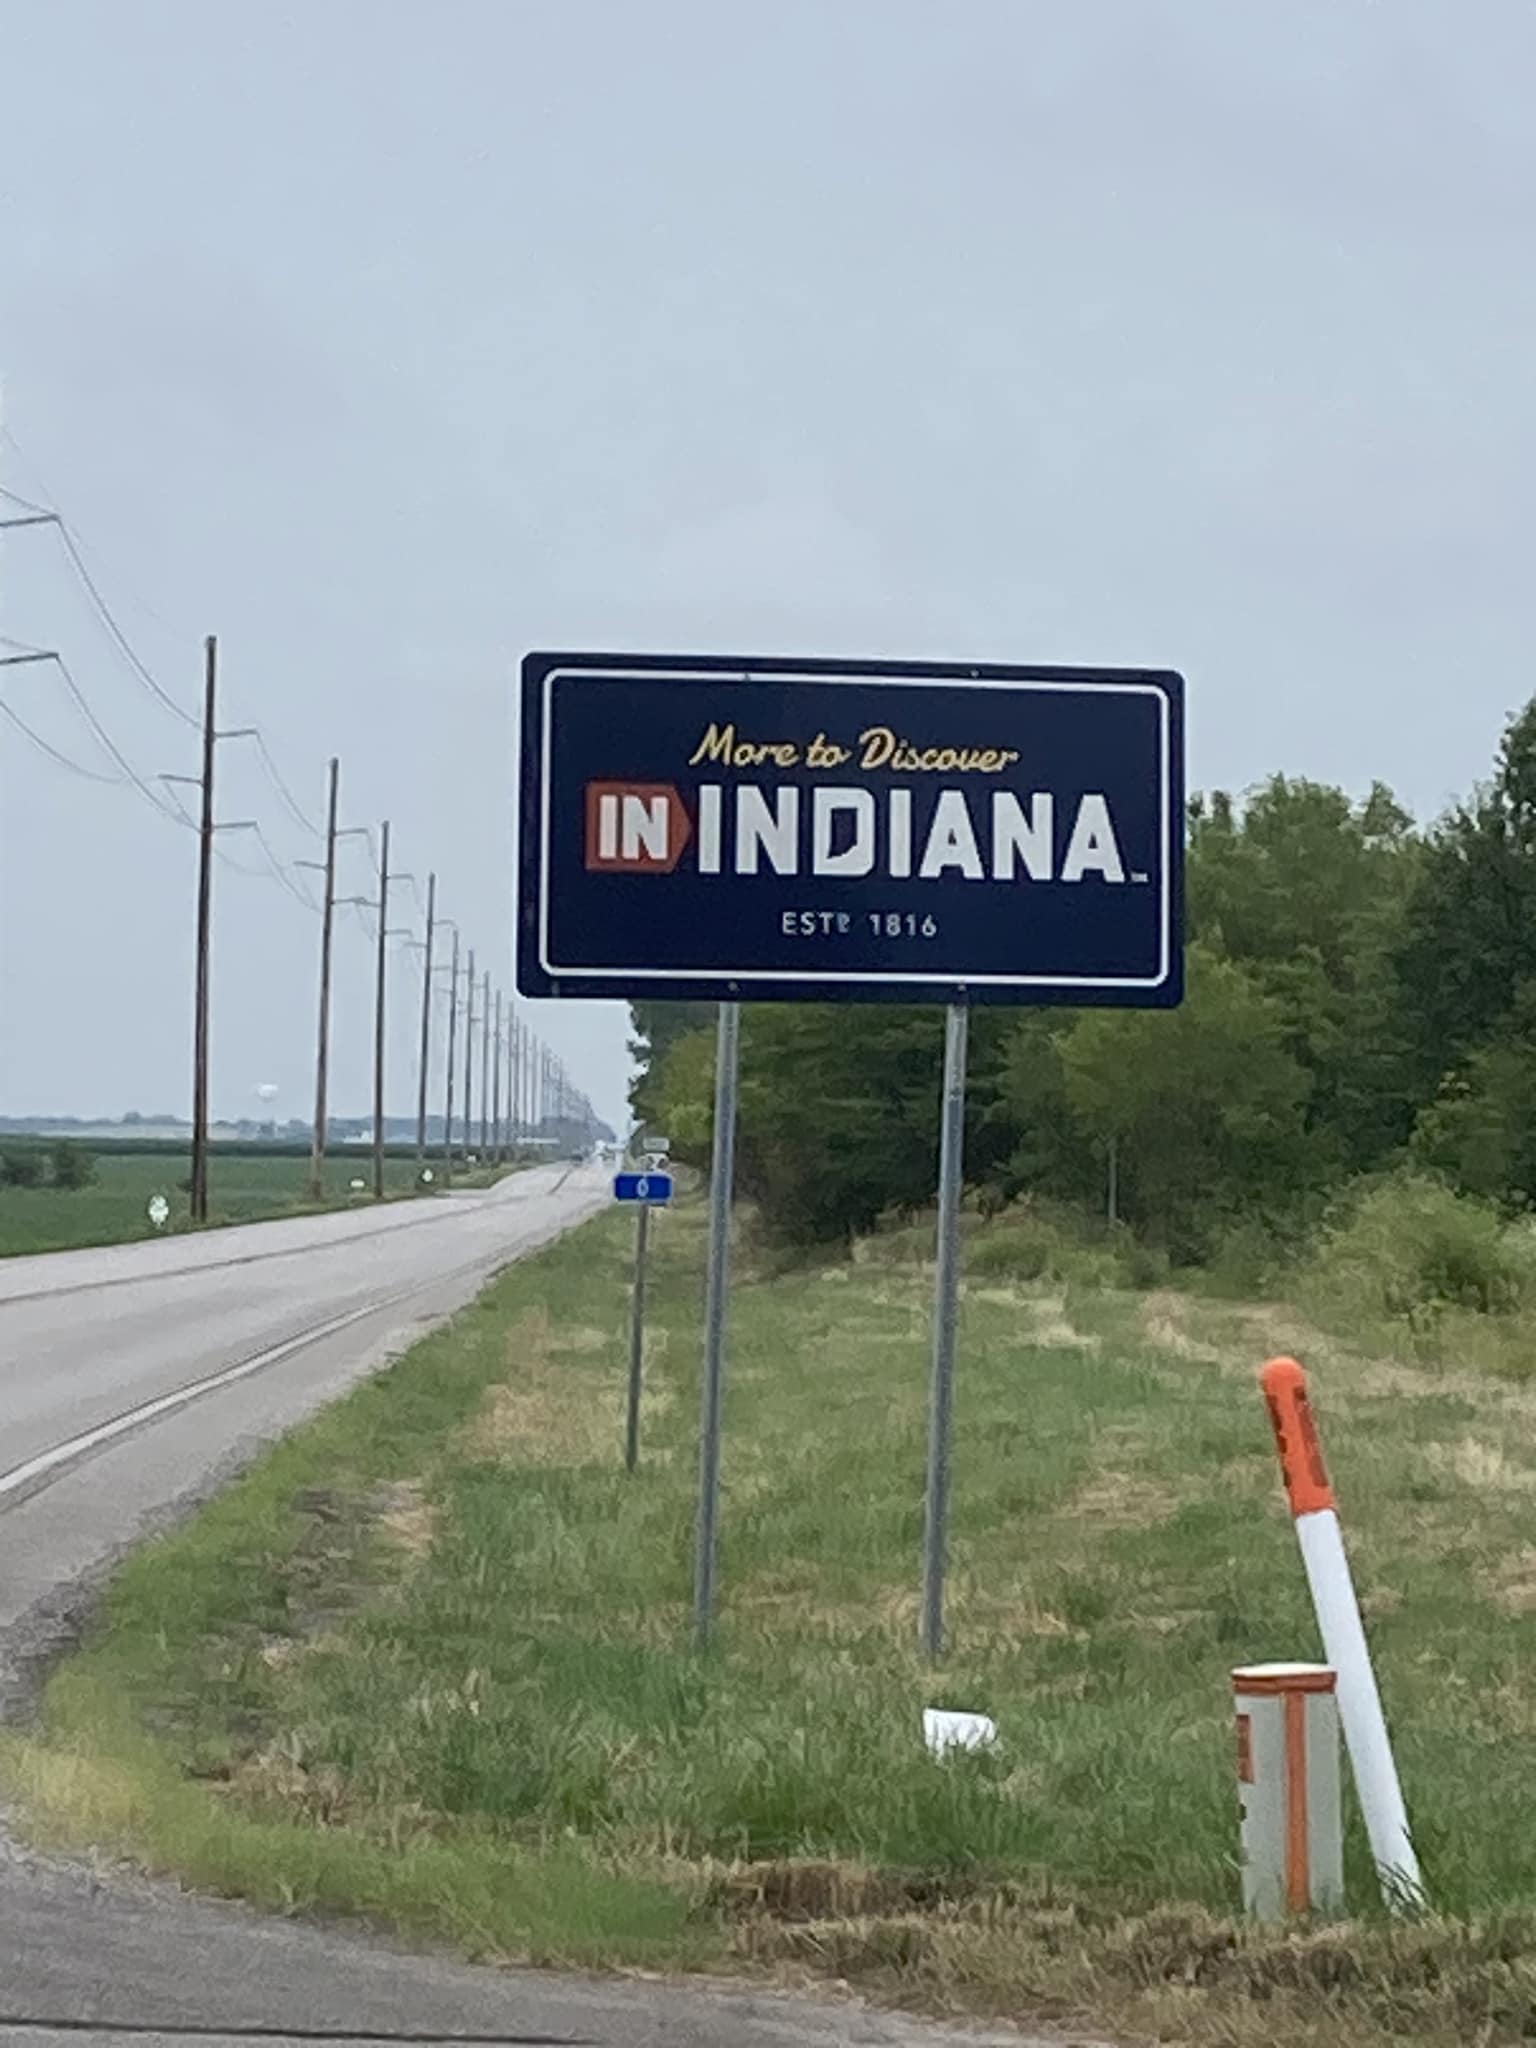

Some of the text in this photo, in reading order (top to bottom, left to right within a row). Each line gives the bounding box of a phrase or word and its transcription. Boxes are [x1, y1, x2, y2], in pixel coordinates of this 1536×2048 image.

[690, 725, 1018, 773] More to Discover
[598, 785, 1125, 884] IN INDIANA
[870, 914, 937, 937] 1816
